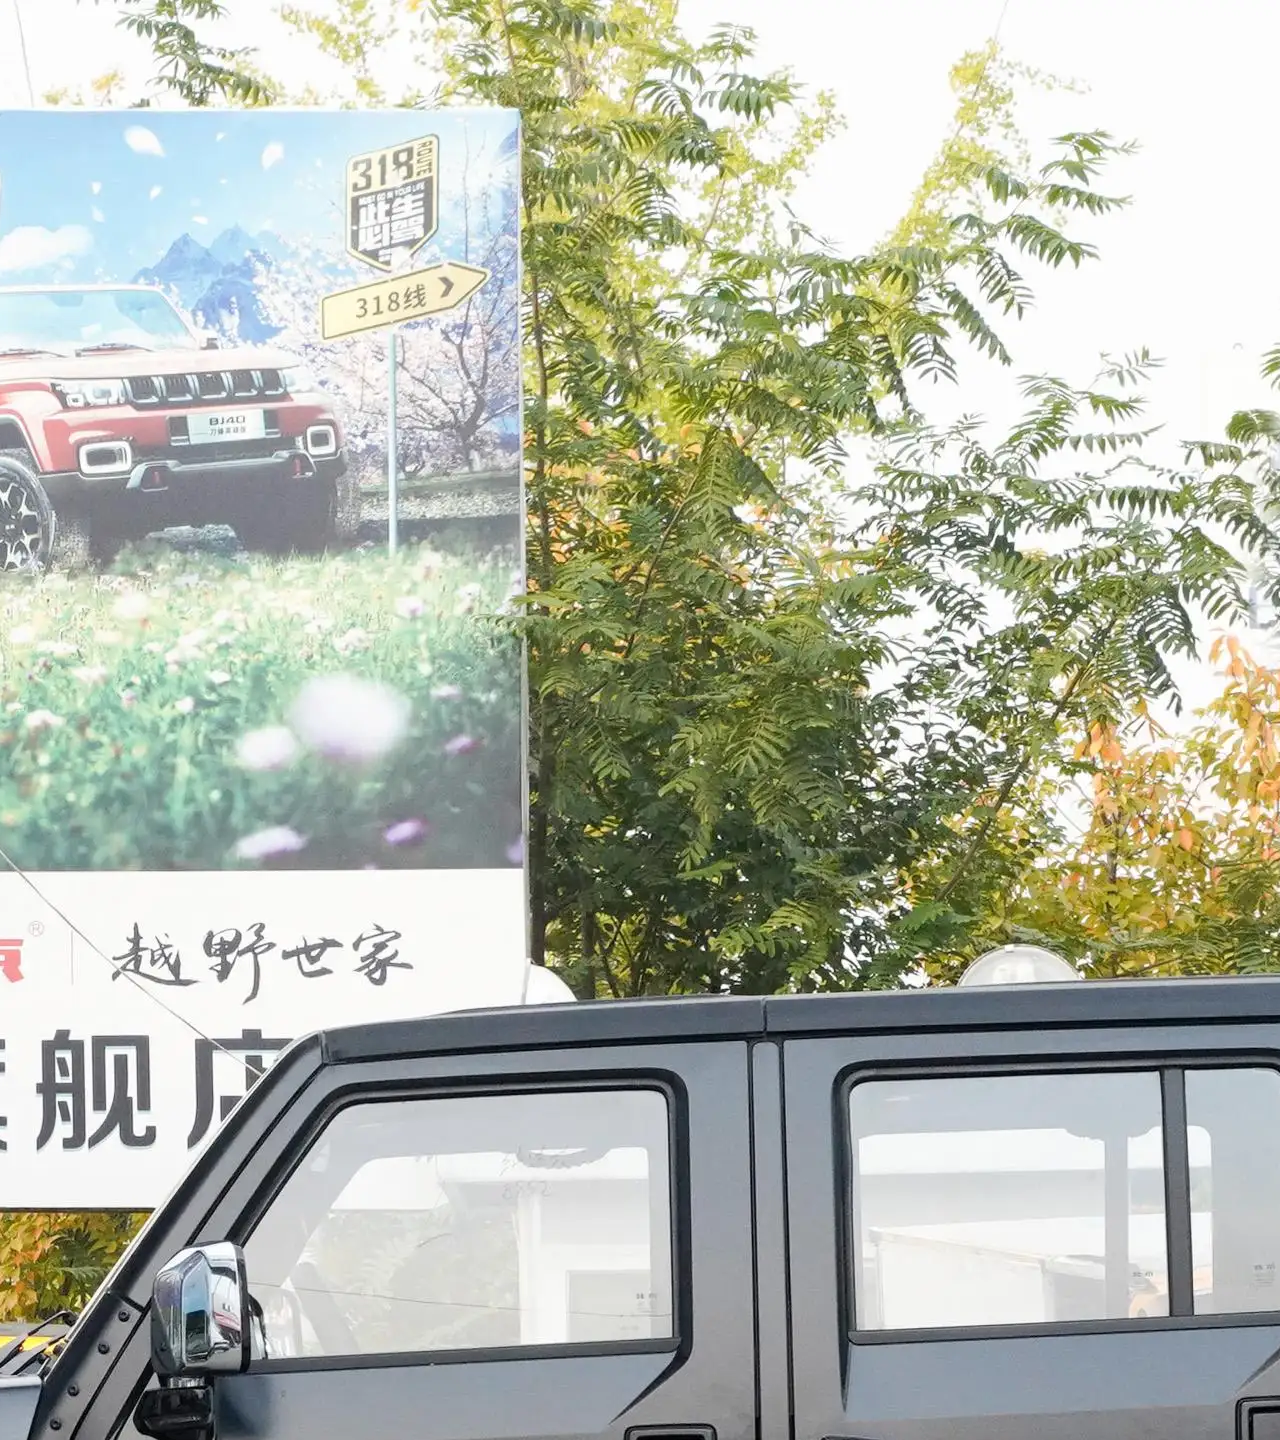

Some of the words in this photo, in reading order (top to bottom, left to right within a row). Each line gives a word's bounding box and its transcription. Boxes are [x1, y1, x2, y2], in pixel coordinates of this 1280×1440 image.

[352, 146, 414, 193] 318
[416, 140, 433, 176] ROUTE
[355, 284, 427, 319] 318线
[111, 922, 414, 1005] 越野世家
